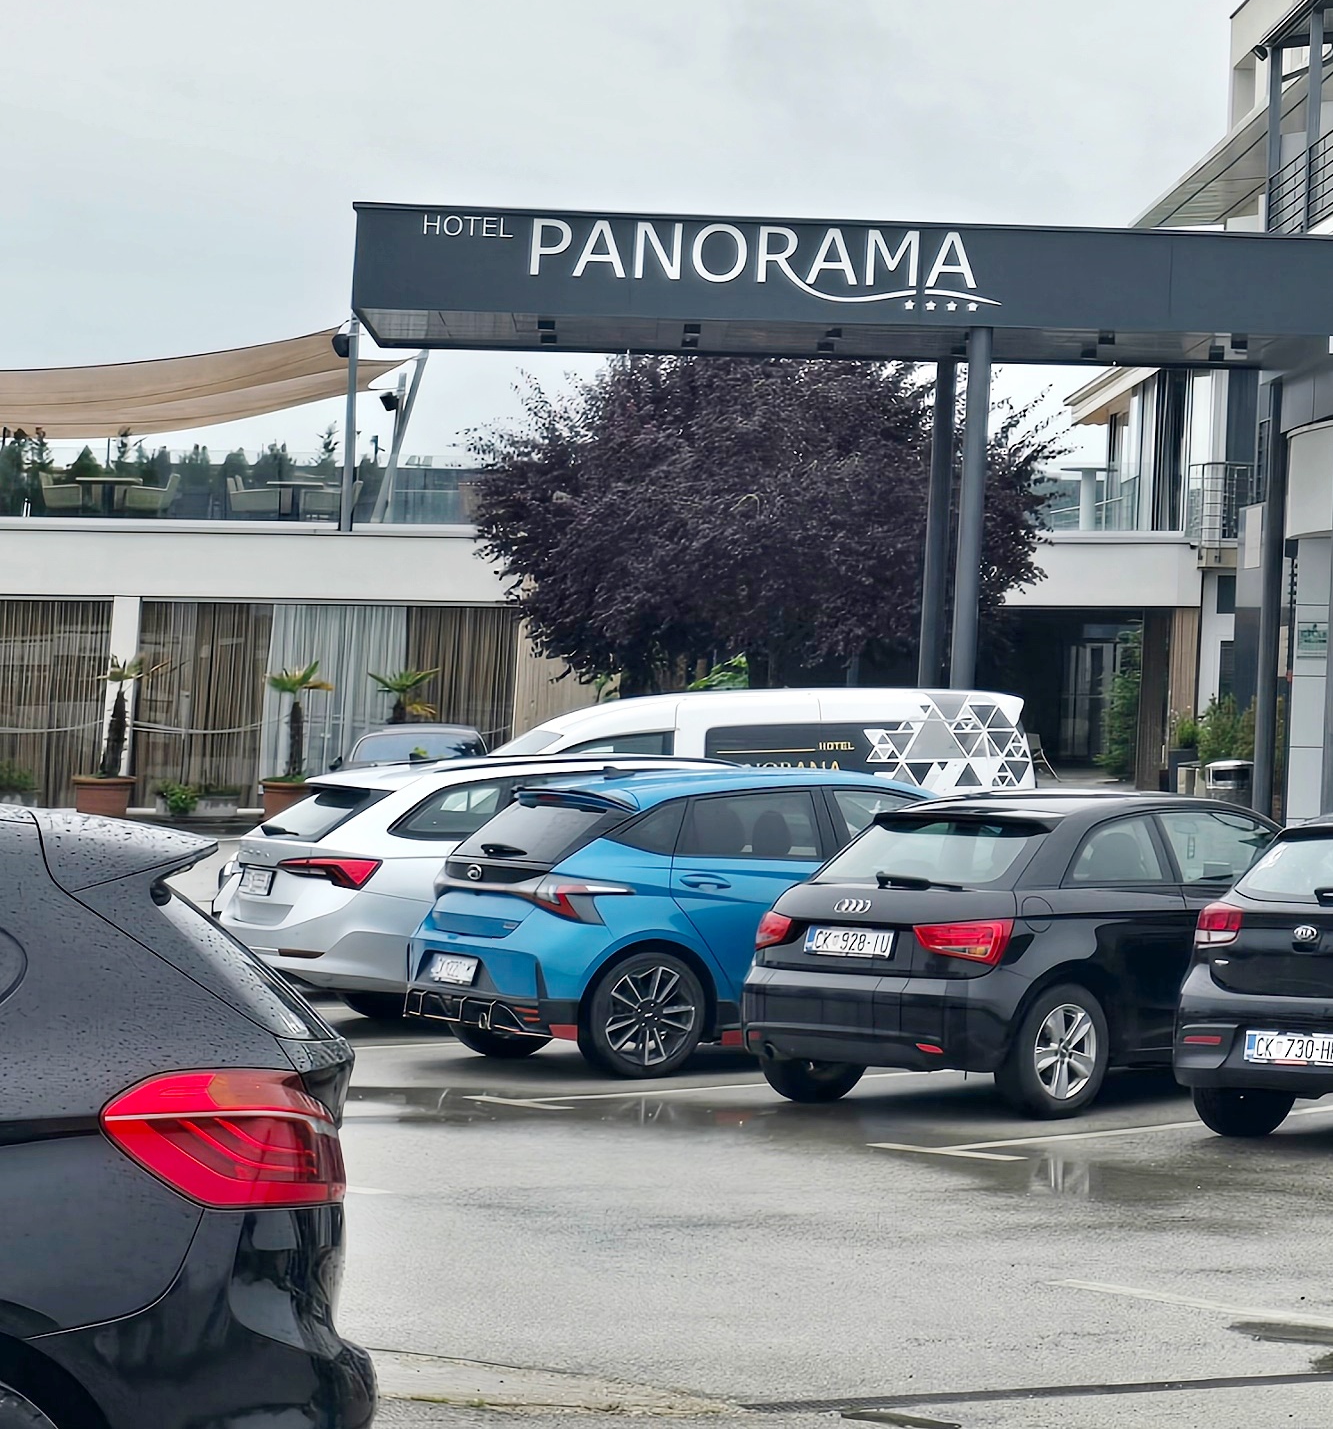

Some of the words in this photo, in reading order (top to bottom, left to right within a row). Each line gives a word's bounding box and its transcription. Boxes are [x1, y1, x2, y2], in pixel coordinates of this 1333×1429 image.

[422, 213, 514, 239] HOTEL
[529, 217, 1000, 304] PANORAMA
[818, 740, 855, 751] HOTEL
[815, 930, 832, 949] CK
[1256, 1036, 1274, 1058] CK
